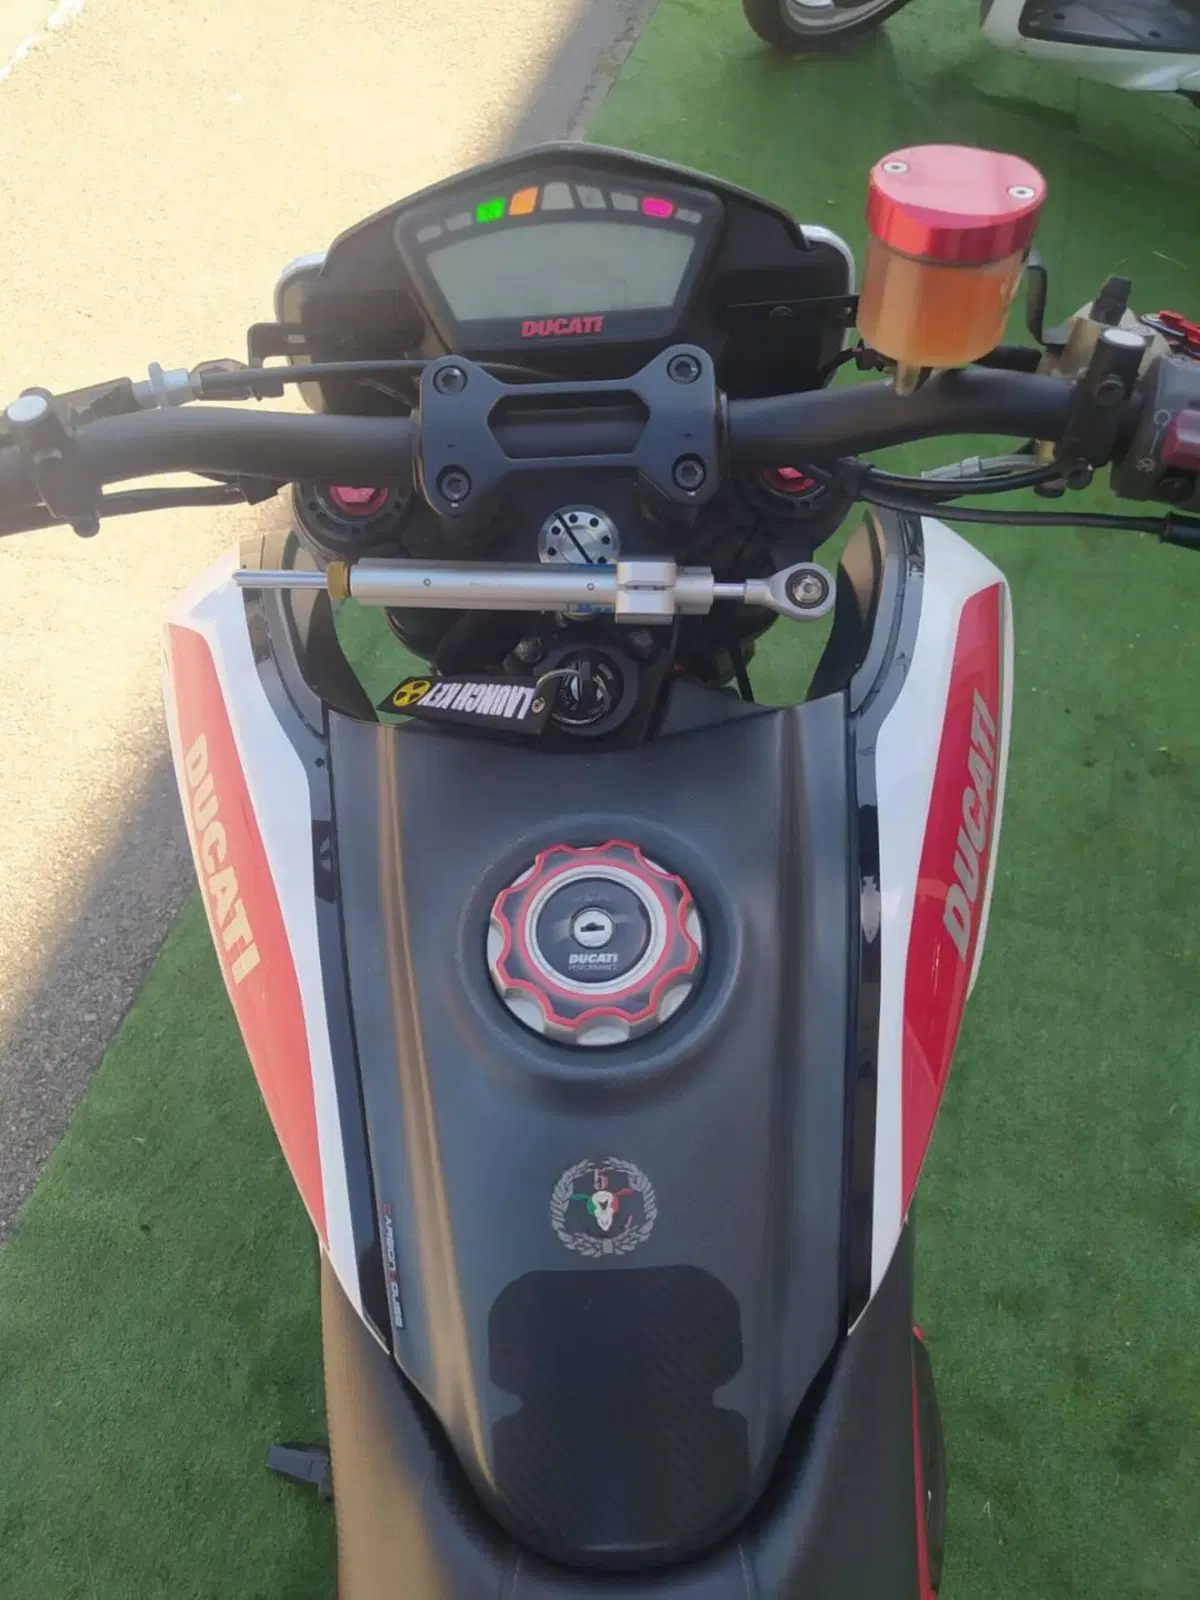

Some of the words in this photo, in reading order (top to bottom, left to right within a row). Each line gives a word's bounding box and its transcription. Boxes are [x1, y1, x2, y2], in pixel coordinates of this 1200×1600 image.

[521, 316, 605, 337] DUCATI
[417, 682, 462, 710] KEY
[452, 683, 535, 720] LAUNCH
[943, 687, 997, 962] DUCATI
[185, 732, 261, 985] DUCATI
[568, 952, 619, 964] DUCATI
